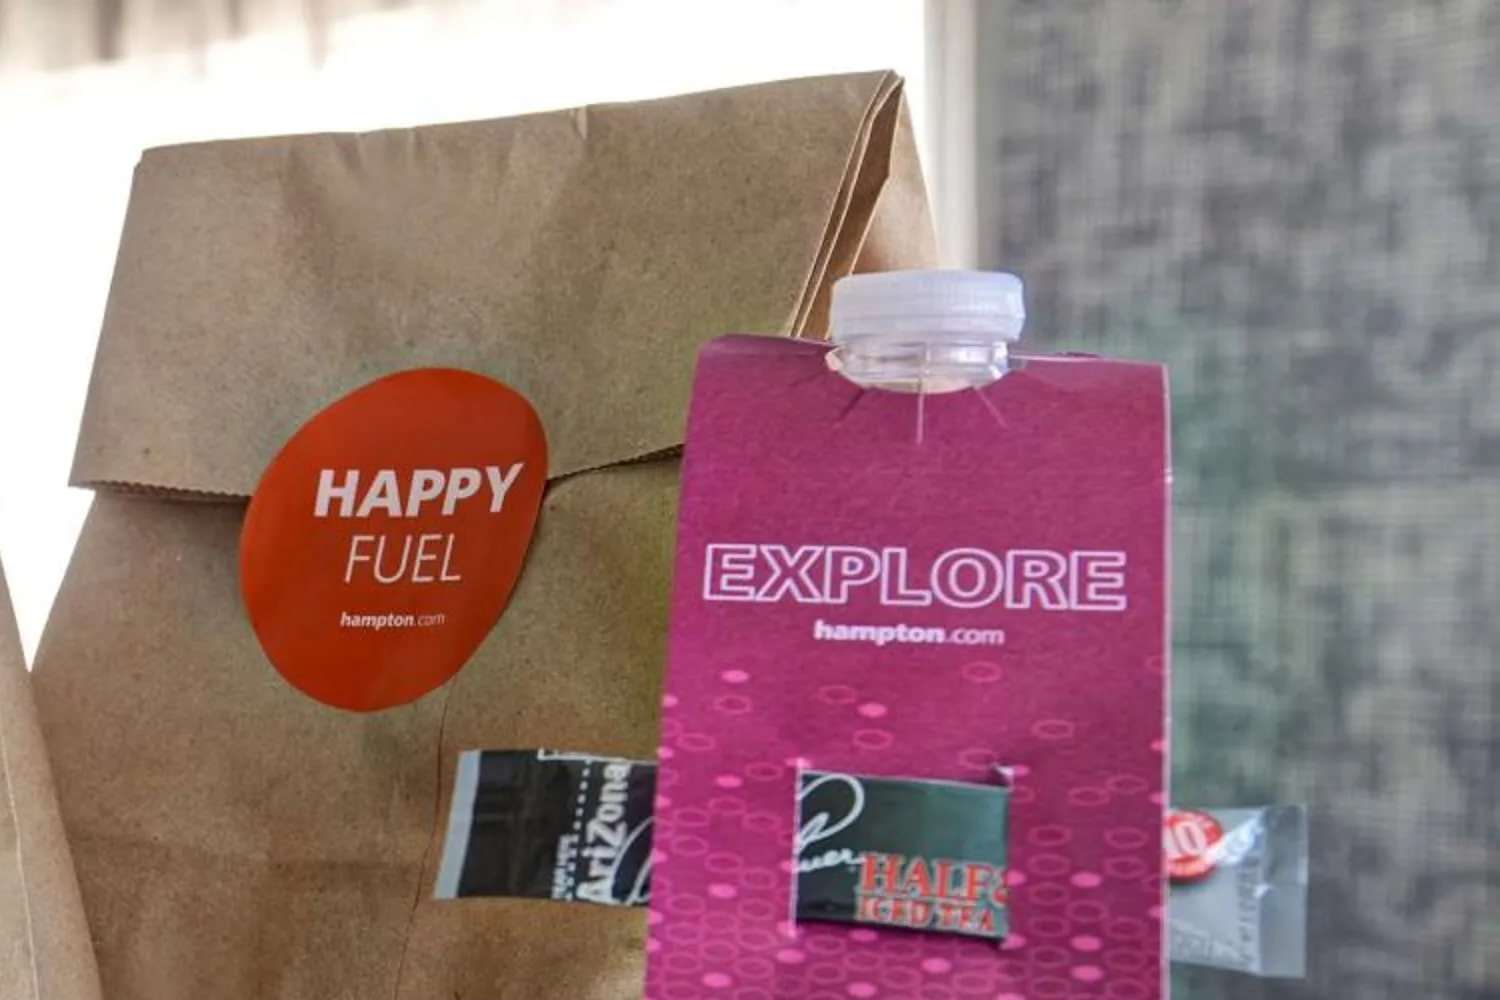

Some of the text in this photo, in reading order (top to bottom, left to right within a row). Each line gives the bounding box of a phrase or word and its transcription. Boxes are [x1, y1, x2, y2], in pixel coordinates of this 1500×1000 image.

[313, 462, 524, 519] HAPPY
[344, 533, 462, 583] FUEL
[702, 543, 1128, 611] EXPLORE
[339, 610, 446, 632] hampton.com
[813, 619, 1006, 646] hampton.com
[859, 850, 994, 906] HALF
[933, 901, 999, 936] TEA
